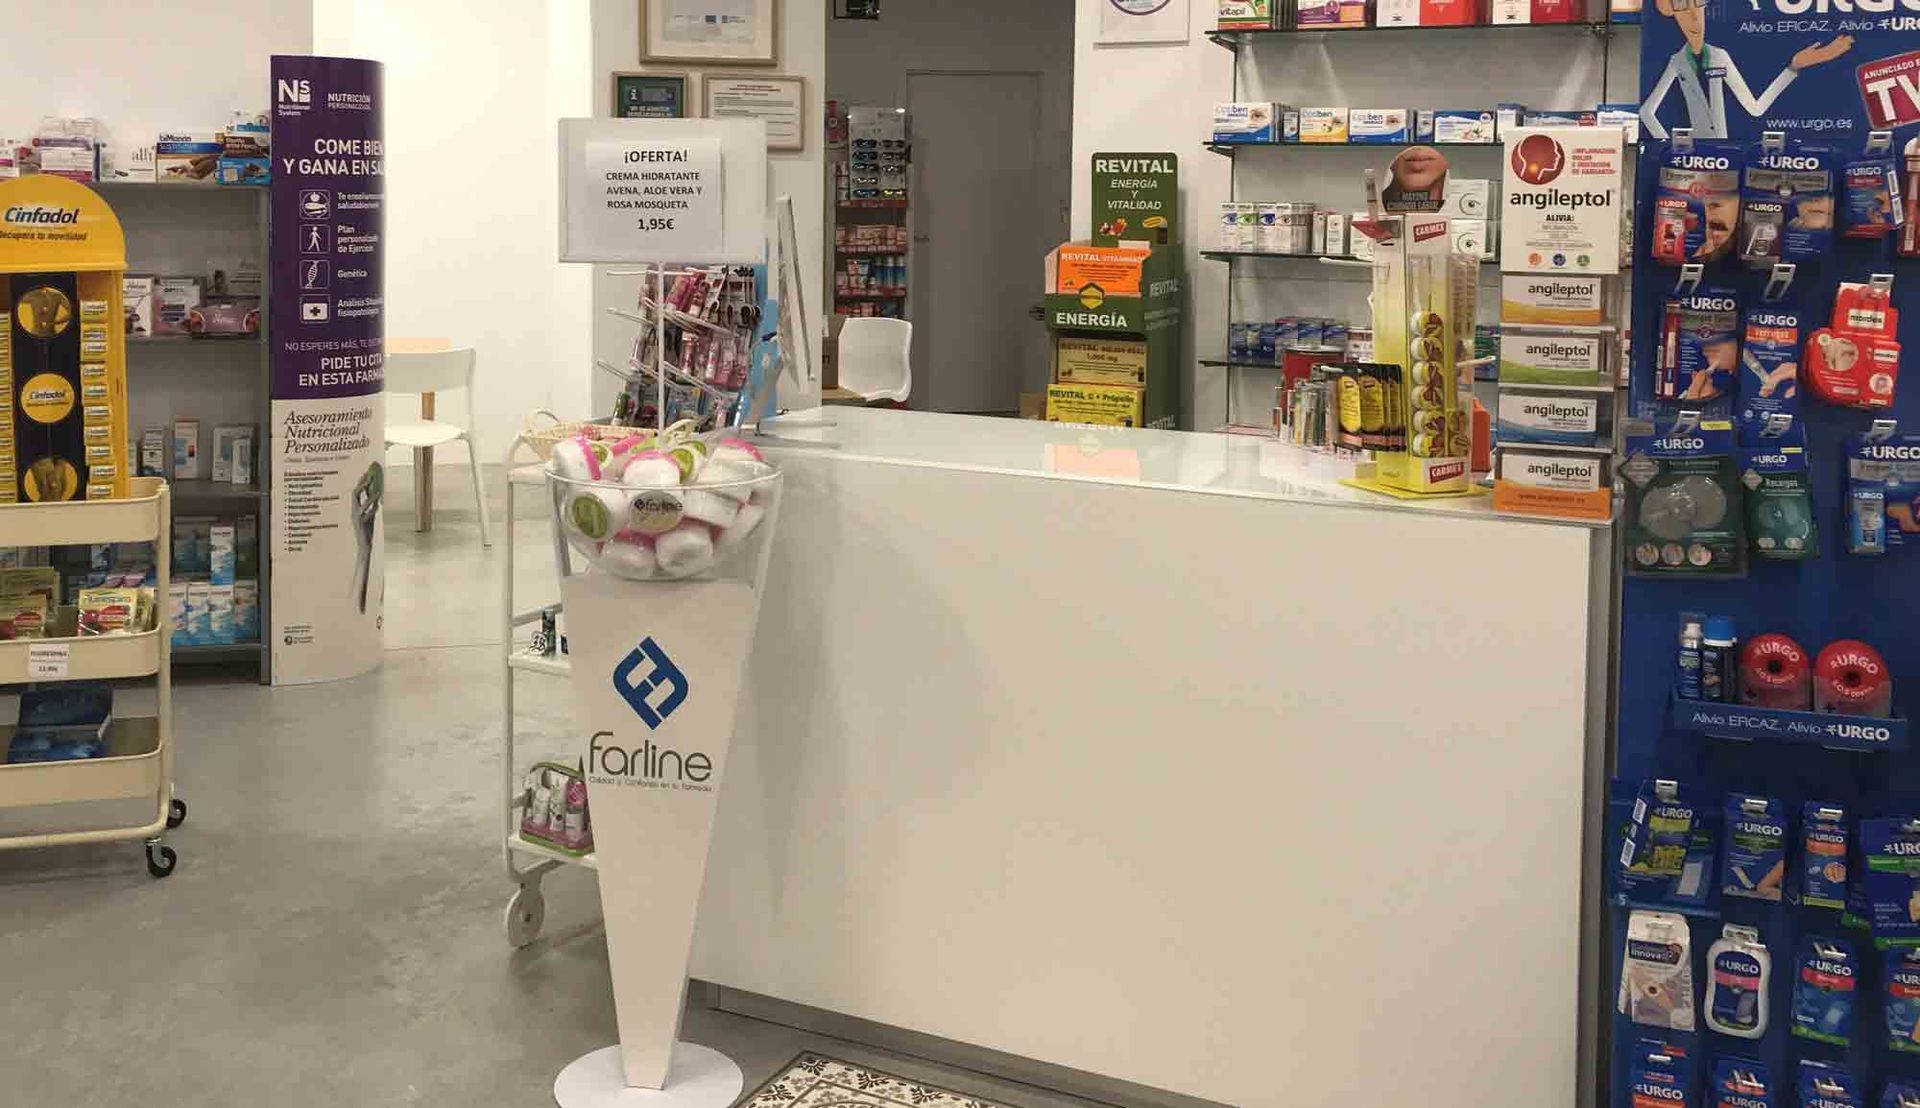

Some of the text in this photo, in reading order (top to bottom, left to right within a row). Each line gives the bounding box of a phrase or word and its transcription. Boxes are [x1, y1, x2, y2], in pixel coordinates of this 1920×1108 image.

[1738, 22, 1772, 32] Alivio
[1838, 19, 1873, 30] Alivio
[1864, 61, 1914, 79] ANUNCIADO
[328, 92, 370, 102] NUTRICIÓN
[1767, 119, 1852, 131] www.urgo.es
[314, 139, 361, 155] COME
[624, 150, 688, 163] ¡OFERTA!
[1682, 157, 1729, 169] URGO
[1769, 157, 1819, 169] URGO
[283, 158, 295, 175] Y
[298, 159, 349, 175] GANA
[352, 160, 369, 175] EN
[1096, 160, 1174, 173] REVITAL
[1852, 167, 1881, 176] URGO
[606, 172, 700, 181] CREMA HIDRATANTE
[1110, 178, 1158, 189] ENERGÍA
[606, 187, 702, 197] AVENA, ALOE VERA Y
[1107, 200, 1162, 210] VITALIDAD
[1511, 188, 1610, 210] angileptol
[634, 202, 688, 211] MOSQUETA
[1754, 203, 1782, 212] URGO
[5, 207, 79, 224] Cinfadol
[338, 225, 354, 233] Plan
[637, 218, 675, 231] 1,95€
[1062, 252, 1100, 261] REVITAL
[1528, 283, 1593, 298] angileptol
[1691, 297, 1735, 310] URGO
[1056, 311, 1128, 327] ENERGÍA
[1759, 315, 1797, 326] URGO
[285, 343, 298, 351] NO
[300, 341, 339, 351] ESPERES
[1526, 344, 1590, 358] angileptol
[321, 352, 382, 370] PIDE TU CITA
[299, 373, 318, 386] EN
[322, 372, 354, 385] ESTA
[1049, 390, 1084, 400] REVITAL
[284, 408, 372, 424] Asesoramiento
[1524, 404, 1588, 418] angileptol
[285, 421, 360, 439] Nutricional
[284, 437, 370, 454] Personalizado
[1663, 438, 1704, 449] URGO
[1759, 455, 1787, 463] URGO
[1873, 446, 1920, 459] URGO
[1528, 463, 1591, 478] angileptol
[1761, 641, 1799, 662] URGO
[1837, 653, 1878, 674] URGO
[1692, 712, 1724, 724] Alivio
[1788, 722, 1821, 733] Alivio
[1838, 724, 1890, 741] URGO
[1662, 808, 1693, 818] URGO
[1744, 823, 1782, 836] URGO
[1816, 833, 1844, 843] URGO
[1726, 961, 1759, 974] URGO
[1817, 961, 1851, 976] URGO
[1902, 974, 1920, 985] UR
[1643, 1085, 1683, 1100] URGO
[1732, 1096, 1767, 1108] URGO
